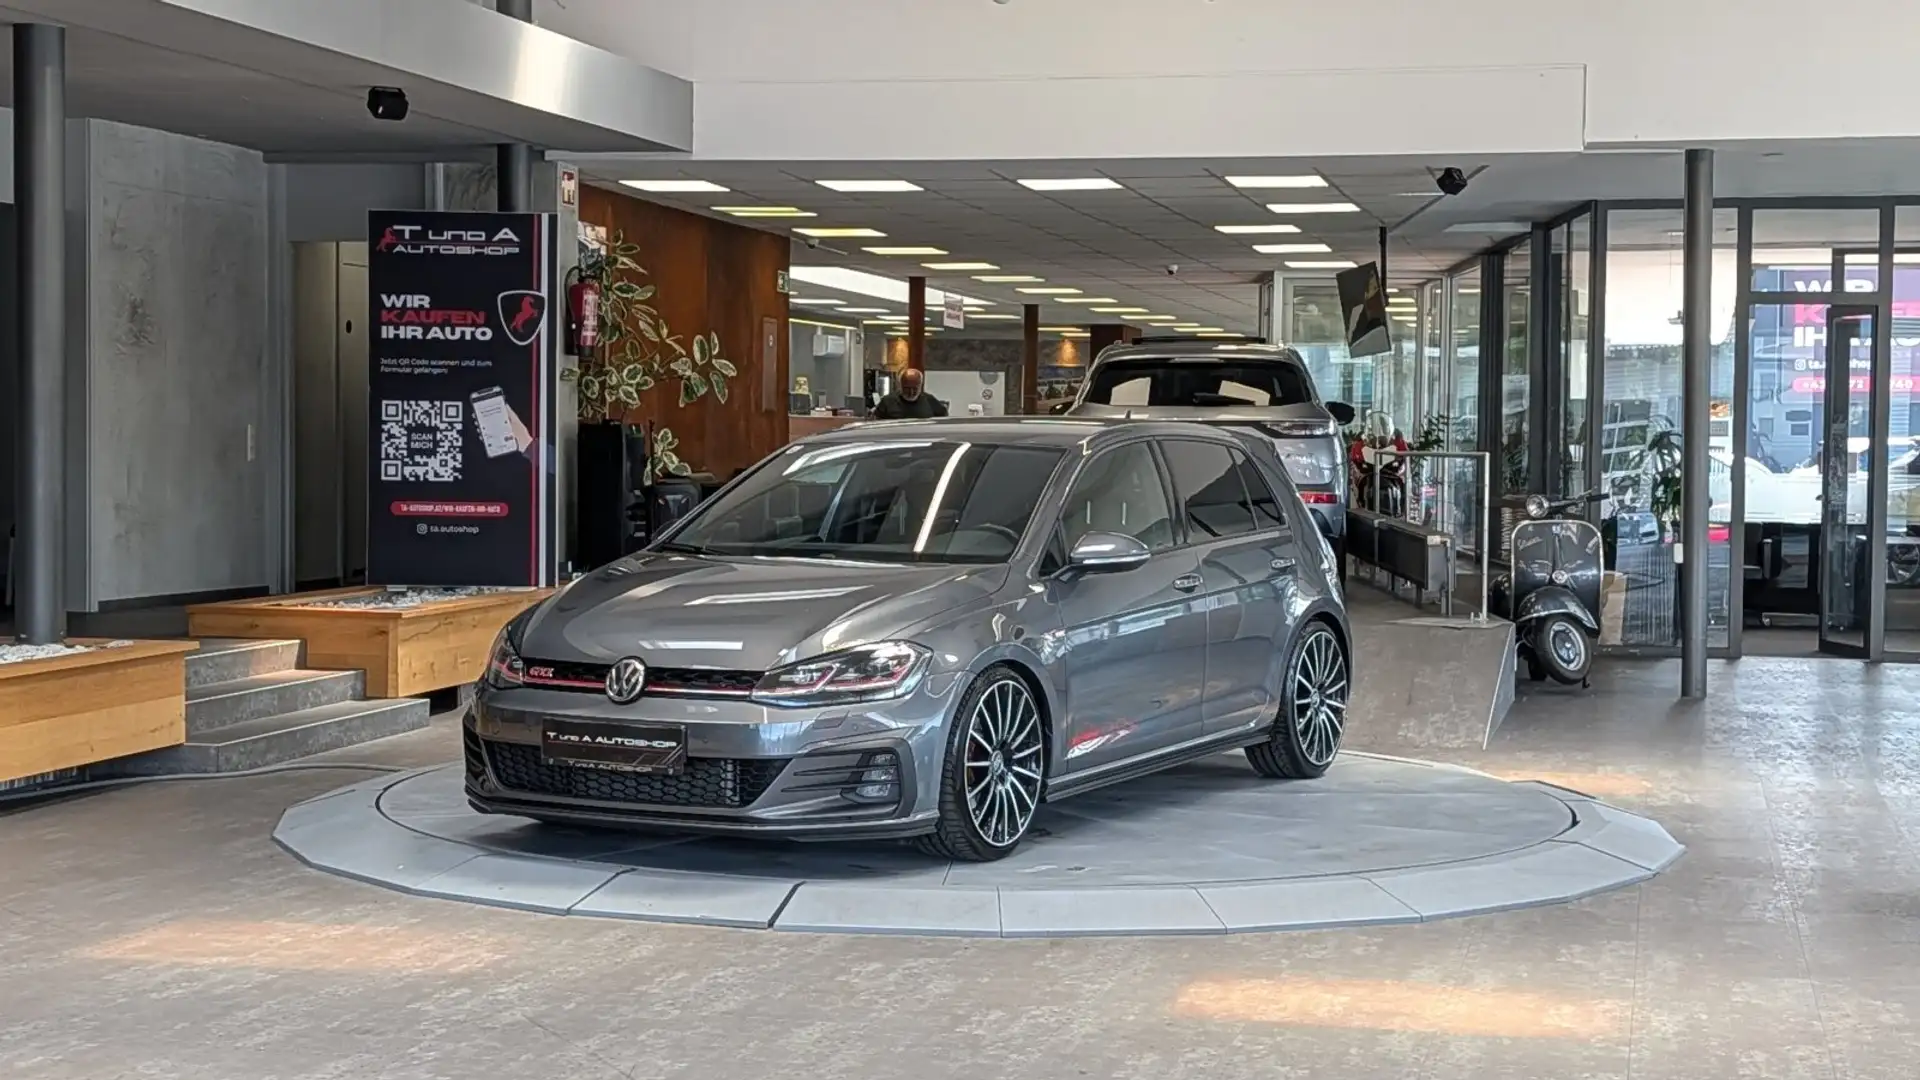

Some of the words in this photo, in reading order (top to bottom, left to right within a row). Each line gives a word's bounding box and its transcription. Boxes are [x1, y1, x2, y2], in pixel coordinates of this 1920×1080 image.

[392, 225, 422, 240] T
[492, 227, 521, 242] A
[392, 244, 520, 256] AUTOSHOP
[380, 293, 431, 308] WIR
[380, 310, 486, 325] KAUFEN
[380, 325, 424, 339] IHR
[426, 326, 493, 341] AUTO
[411, 432, 433, 441] SCAN
[410, 441, 433, 449] MICH
[430, 525, 479, 534] ta.autoshop
[546, 731, 557, 740] T
[582, 735, 592, 743] A
[595, 736, 677, 748] AUTOSHOP
